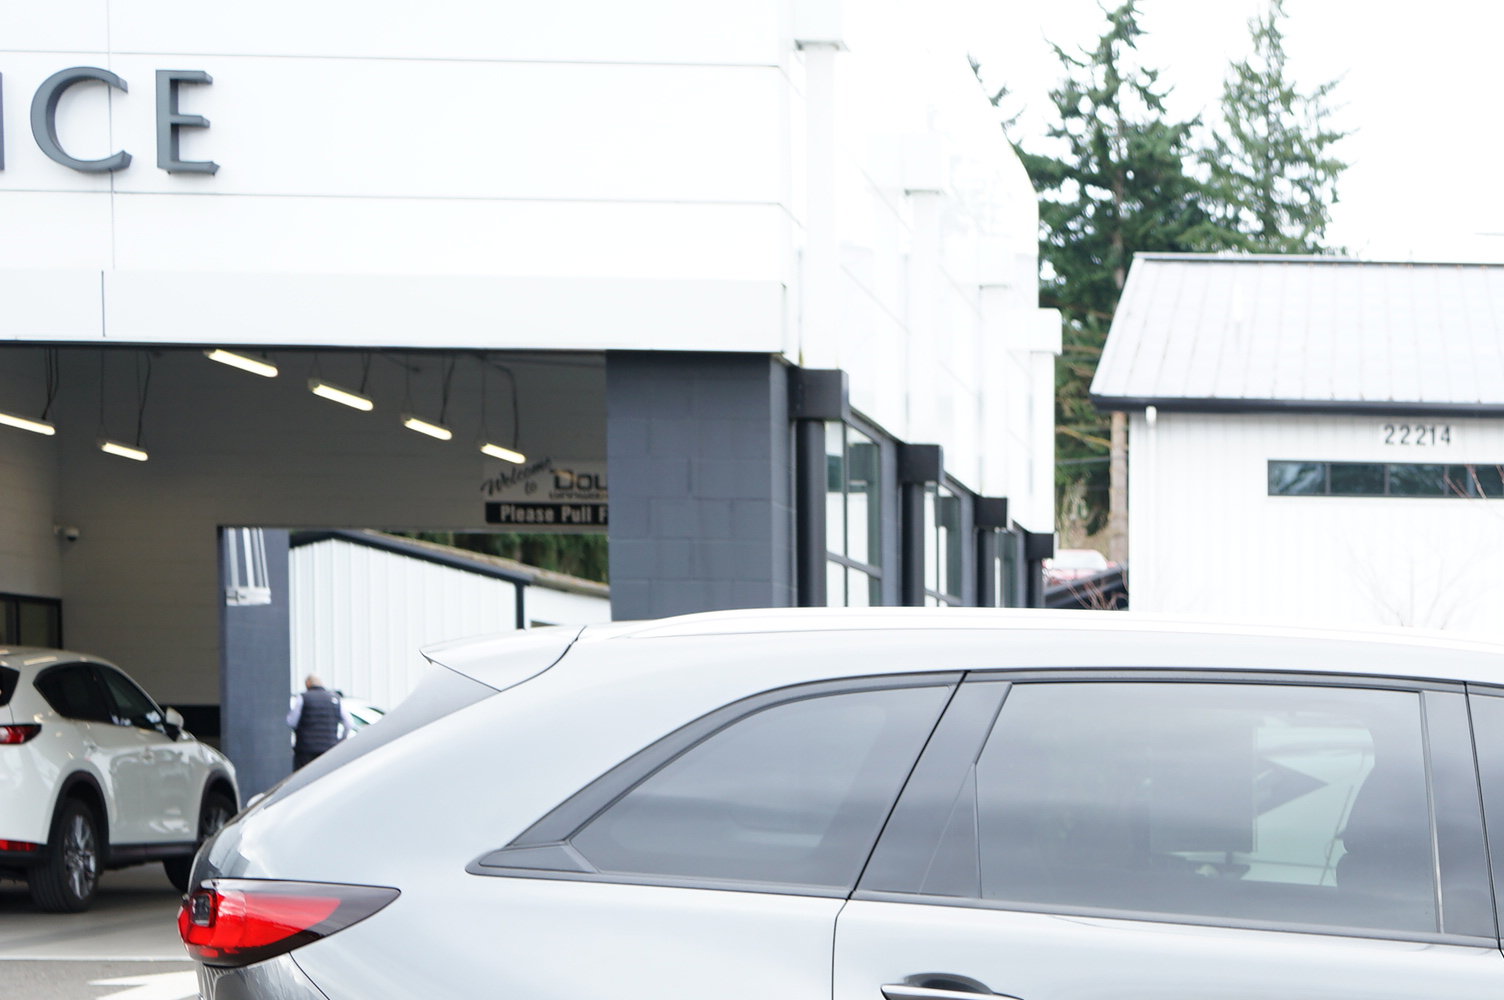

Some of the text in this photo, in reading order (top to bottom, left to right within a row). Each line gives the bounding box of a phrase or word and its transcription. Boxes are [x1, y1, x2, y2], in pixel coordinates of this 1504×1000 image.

[0, 66, 220, 176] CE
[1384, 424, 1451, 446] 22214
[500, 504, 555, 523] Please
[561, 505, 592, 523] Pull
